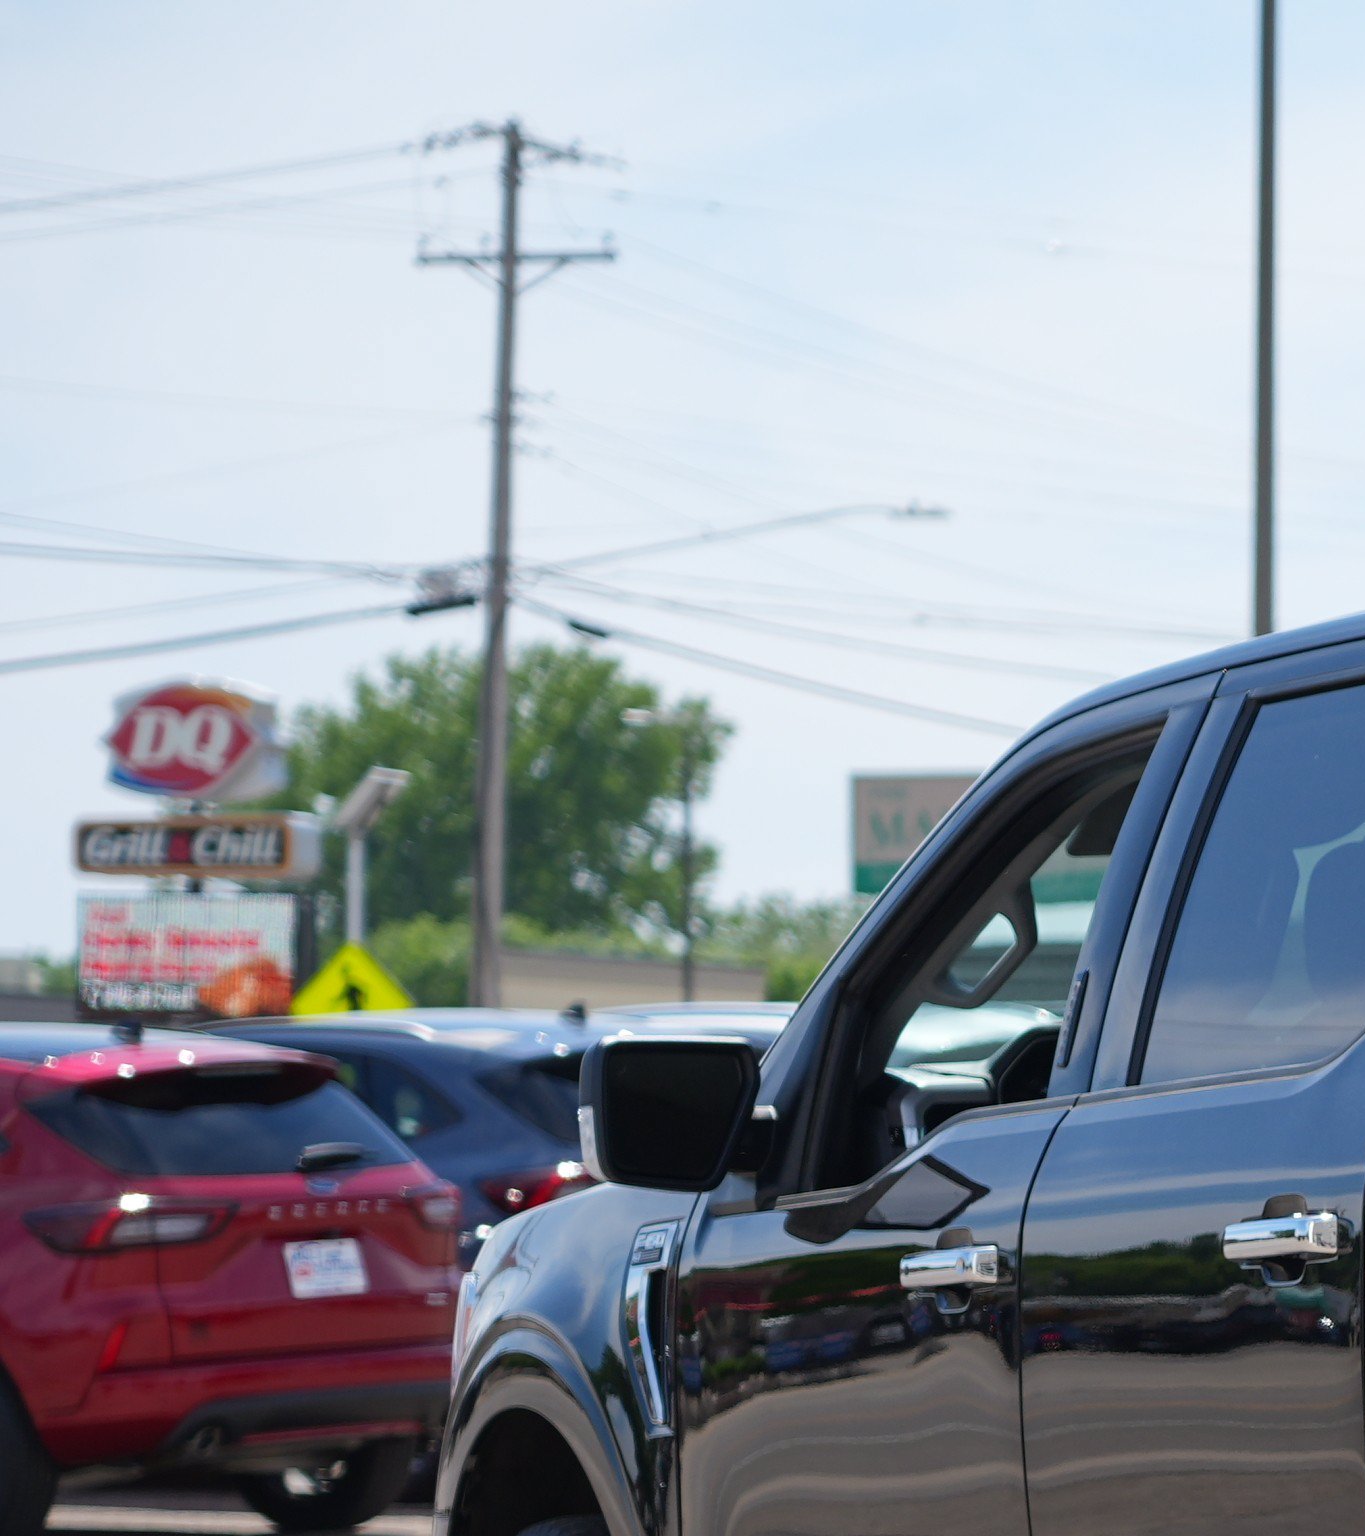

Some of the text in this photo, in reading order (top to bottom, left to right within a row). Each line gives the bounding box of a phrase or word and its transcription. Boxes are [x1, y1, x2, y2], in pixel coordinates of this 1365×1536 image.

[129, 704, 233, 773] DQ
[86, 828, 167, 866] Grill
[193, 827, 281, 866] Chill
